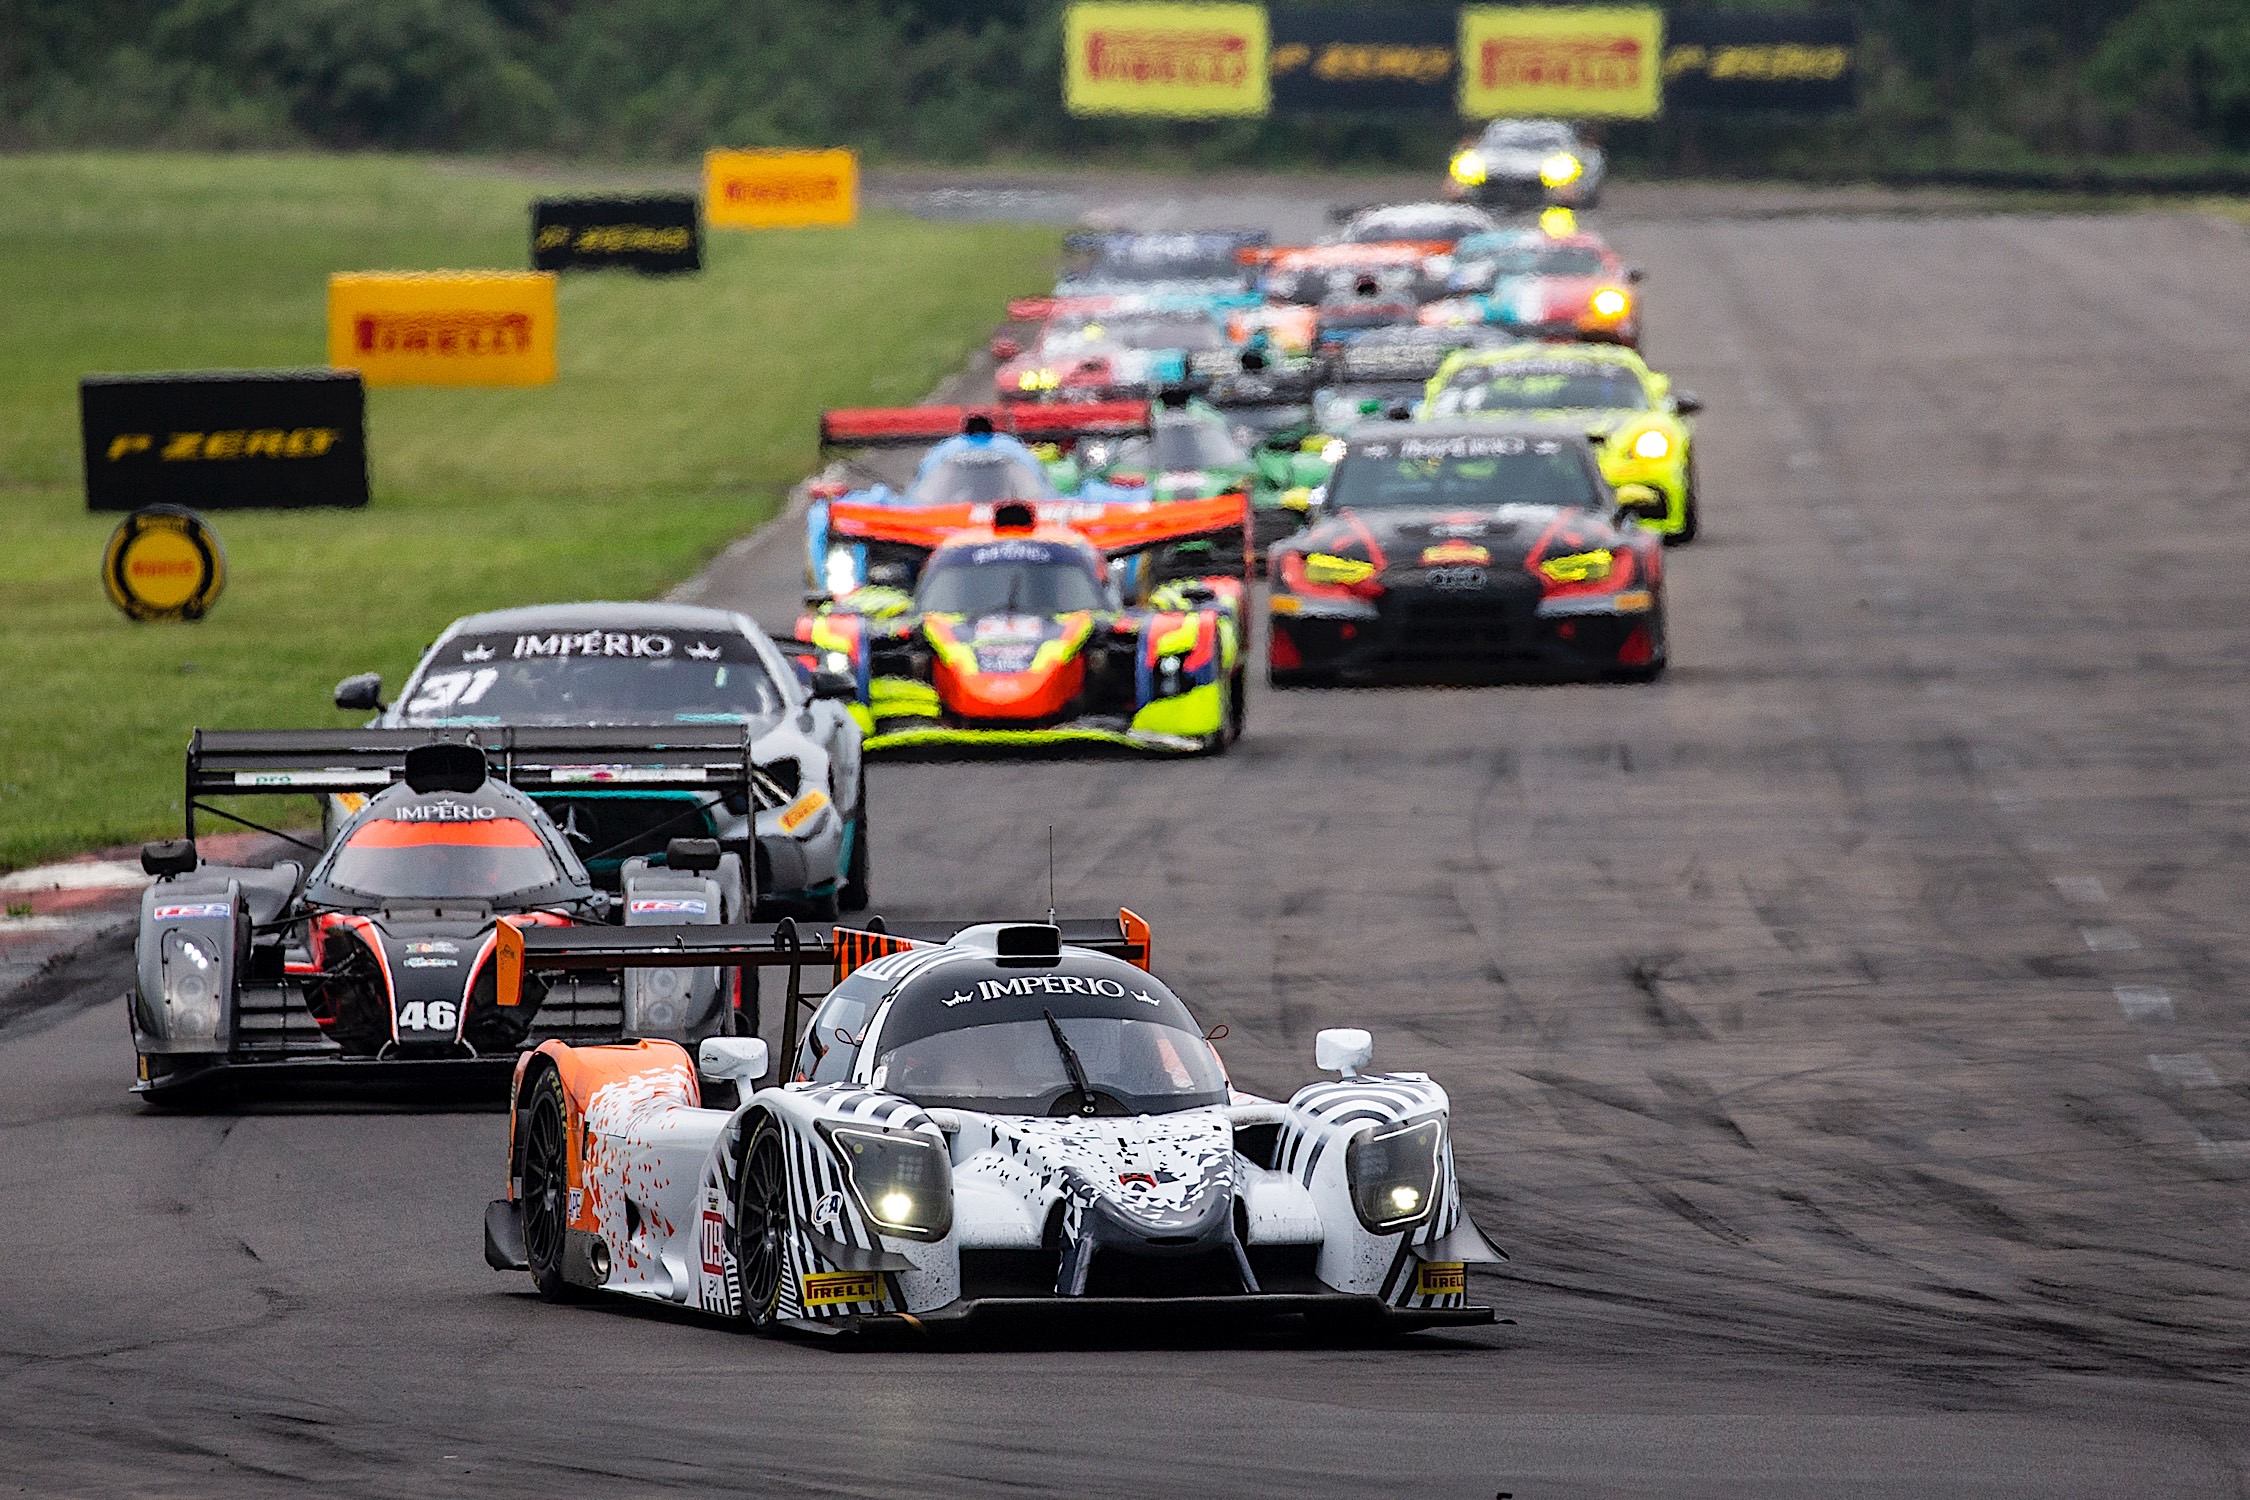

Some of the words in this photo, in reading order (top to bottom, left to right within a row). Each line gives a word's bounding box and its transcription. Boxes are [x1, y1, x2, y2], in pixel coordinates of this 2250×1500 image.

[356, 313, 531, 356] PIRELLI
[108, 434, 151, 461] P
[162, 428, 342, 461] ZERO
[513, 630, 673, 658] IMPÉRIO
[977, 973, 1126, 1000] IMPÉRIO
[399, 1001, 457, 1031] 46
[703, 1218, 722, 1267] 09
